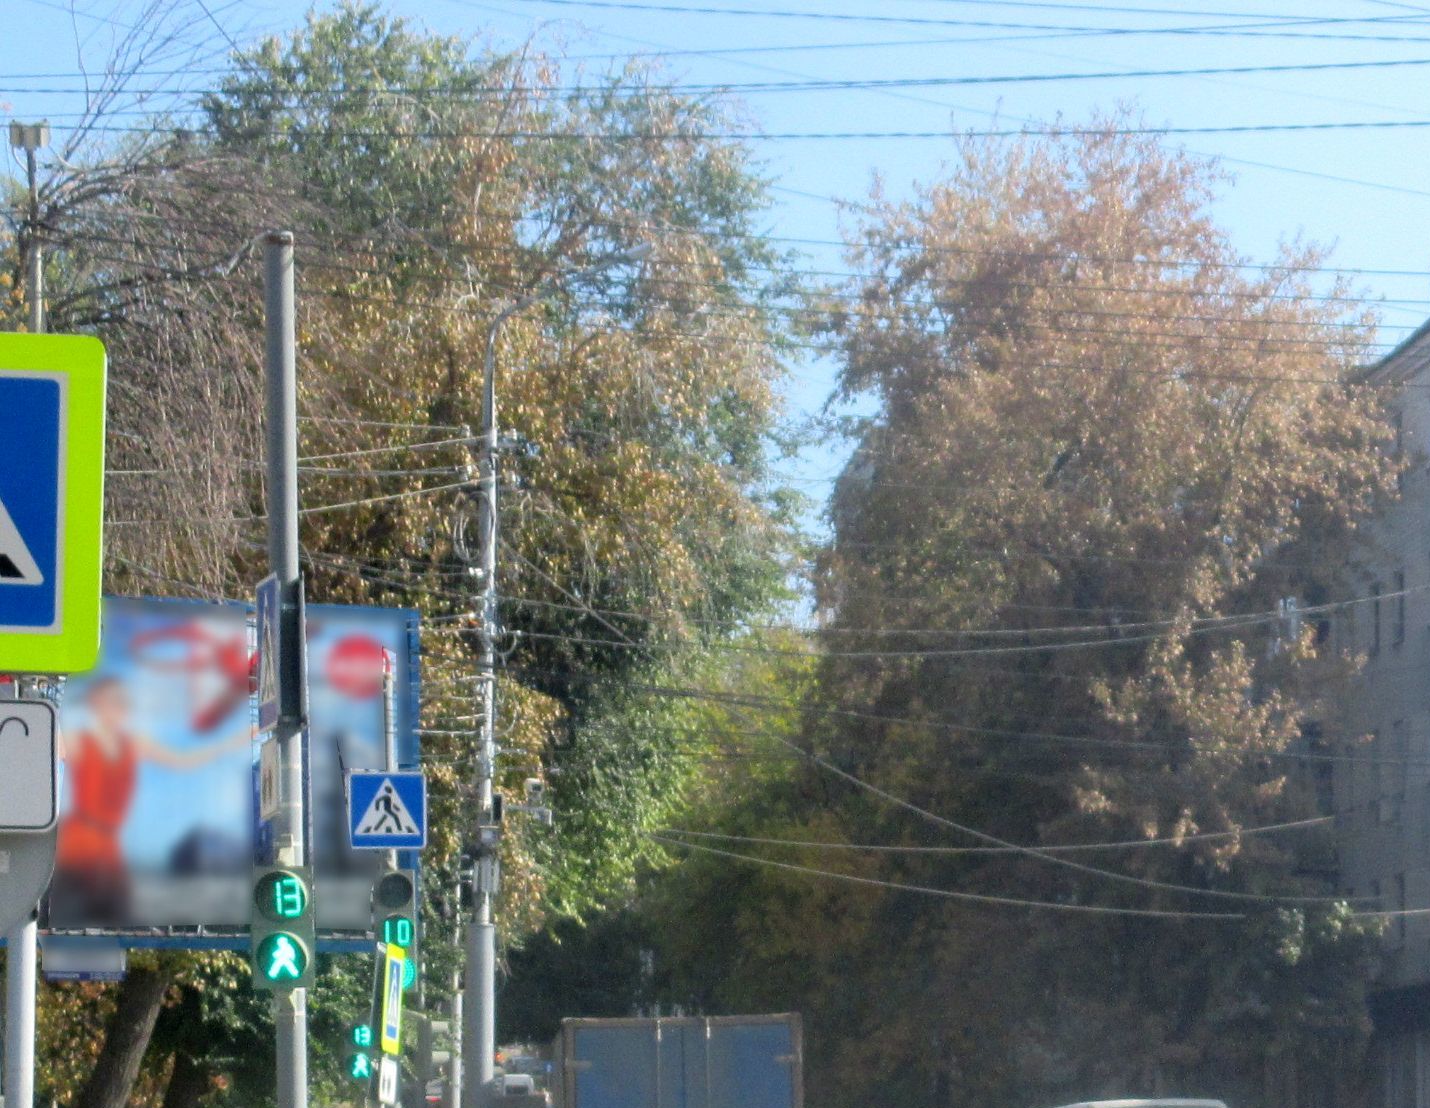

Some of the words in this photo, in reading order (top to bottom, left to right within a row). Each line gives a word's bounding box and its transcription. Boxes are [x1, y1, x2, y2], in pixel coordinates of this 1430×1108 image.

[275, 877, 301, 917] 13
[385, 919, 410, 944] 10
[354, 1026, 371, 1046] 13
